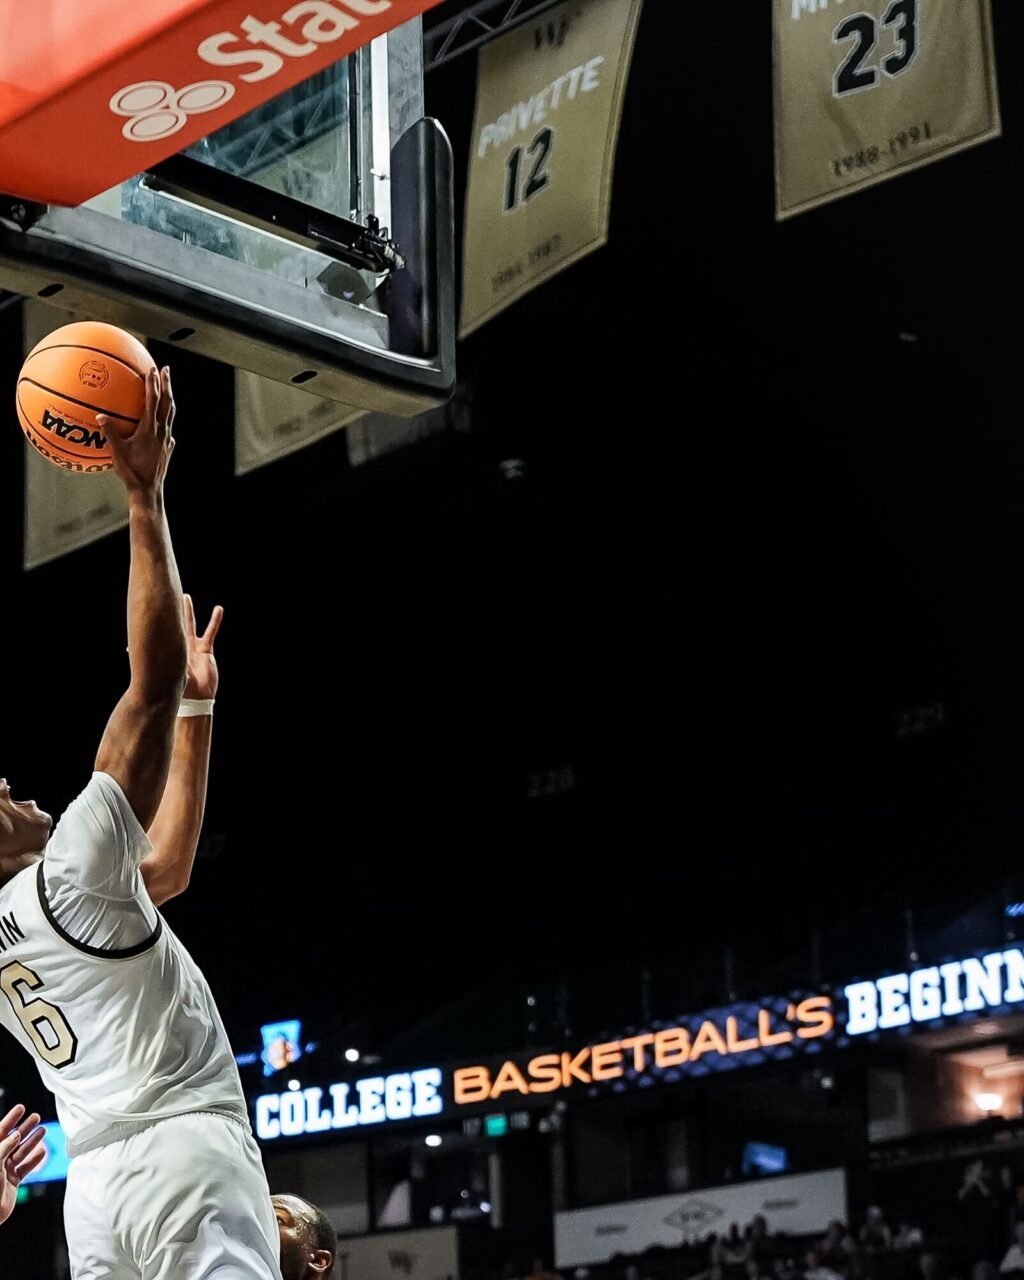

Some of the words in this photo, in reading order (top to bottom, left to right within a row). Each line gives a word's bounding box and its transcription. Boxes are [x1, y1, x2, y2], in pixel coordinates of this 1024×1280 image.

[832, 0, 920, 98] 23
[503, 124, 555, 214] 12
[41, 409, 108, 449] NCAA
[256, 1068, 443, 1139] COLLEGE
[453, 996, 833, 1105] BASKETBALL'S
